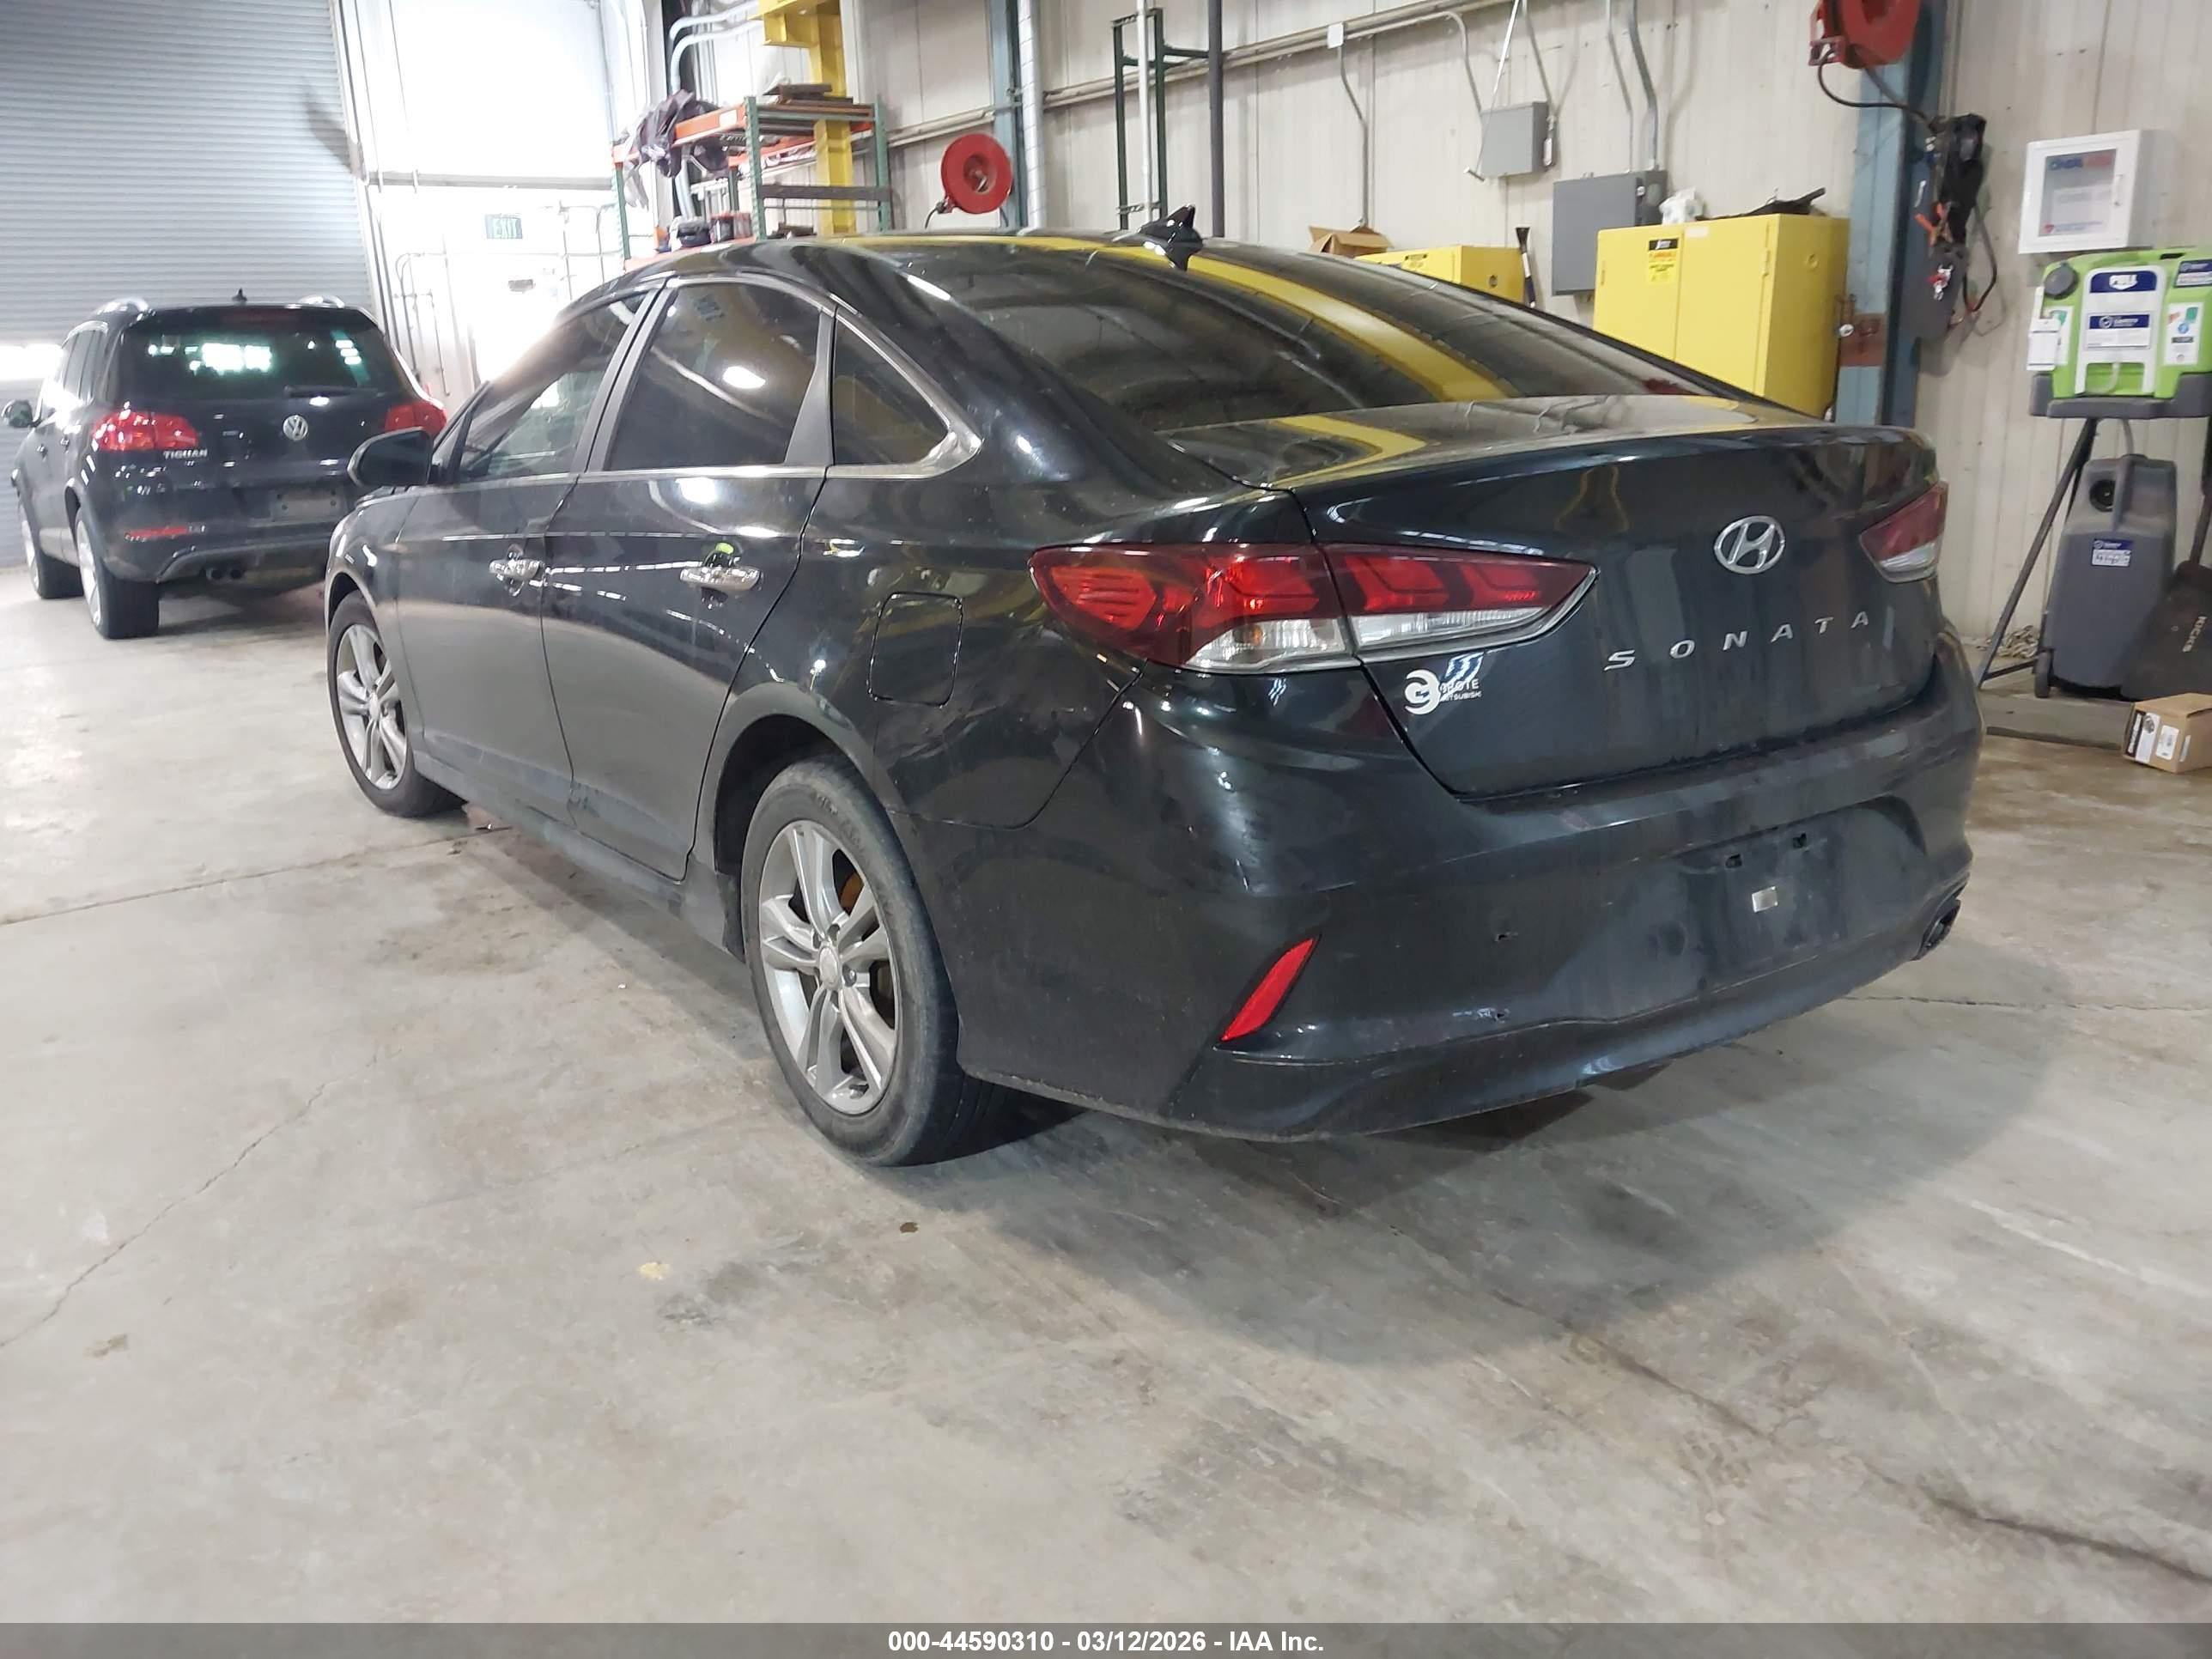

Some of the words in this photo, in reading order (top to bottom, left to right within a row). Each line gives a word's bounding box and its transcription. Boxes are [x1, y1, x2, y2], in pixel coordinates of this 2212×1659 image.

[493, 218, 517, 238] EXIT
[163, 449, 208, 459] TIGUAN
[1604, 611, 1869, 672] SONATA
